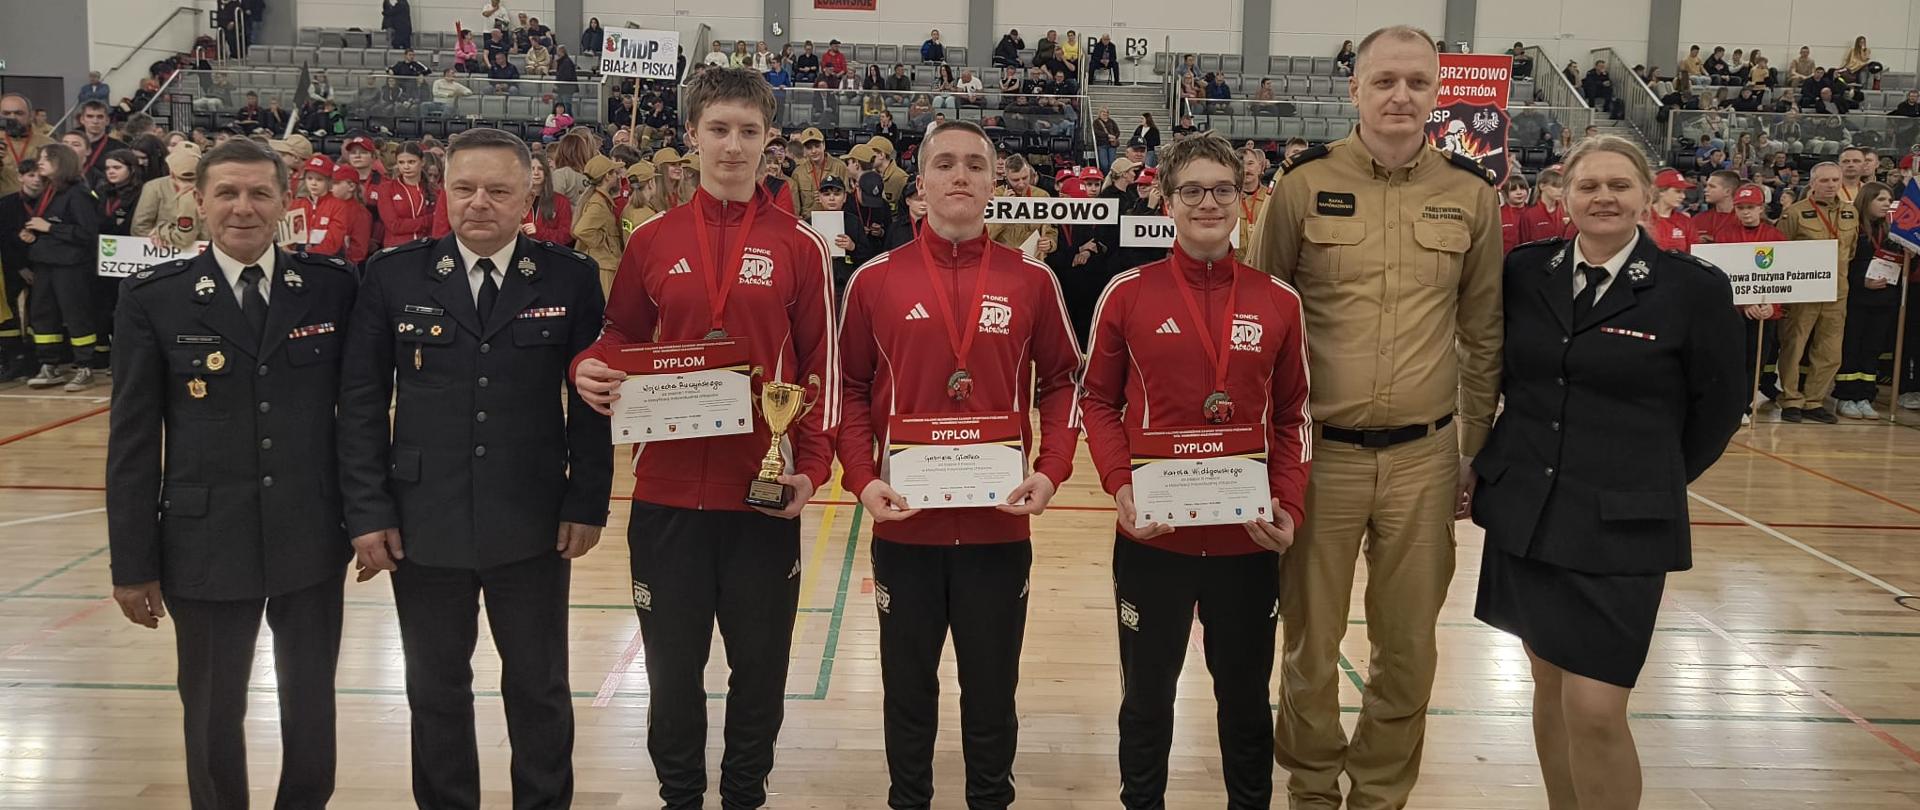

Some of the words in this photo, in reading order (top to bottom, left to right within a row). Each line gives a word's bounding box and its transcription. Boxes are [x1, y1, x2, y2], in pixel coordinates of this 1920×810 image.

[620, 39, 659, 59] MDP
[1126, 37, 1148, 56] B3
[602, 59, 637, 73] BIAŁA
[642, 61, 675, 76] PISKA
[1453, 84, 1497, 97] OSTRÓDA
[984, 202, 1109, 220] GRABOWO
[1134, 225, 1175, 238] DUN
[143, 244, 182, 259] MDP
[101, 261, 152, 274] SZCZE
[1751, 272, 1785, 283] Drużyna
[1786, 269, 1831, 281] Pożarnicza
[1735, 285, 1751, 295] OSP
[1752, 284, 1792, 295] Szkotowo
[653, 356, 705, 369] DYPLOM
[932, 429, 980, 440] DYPLOM
[1174, 442, 1223, 454] DYPLOM
